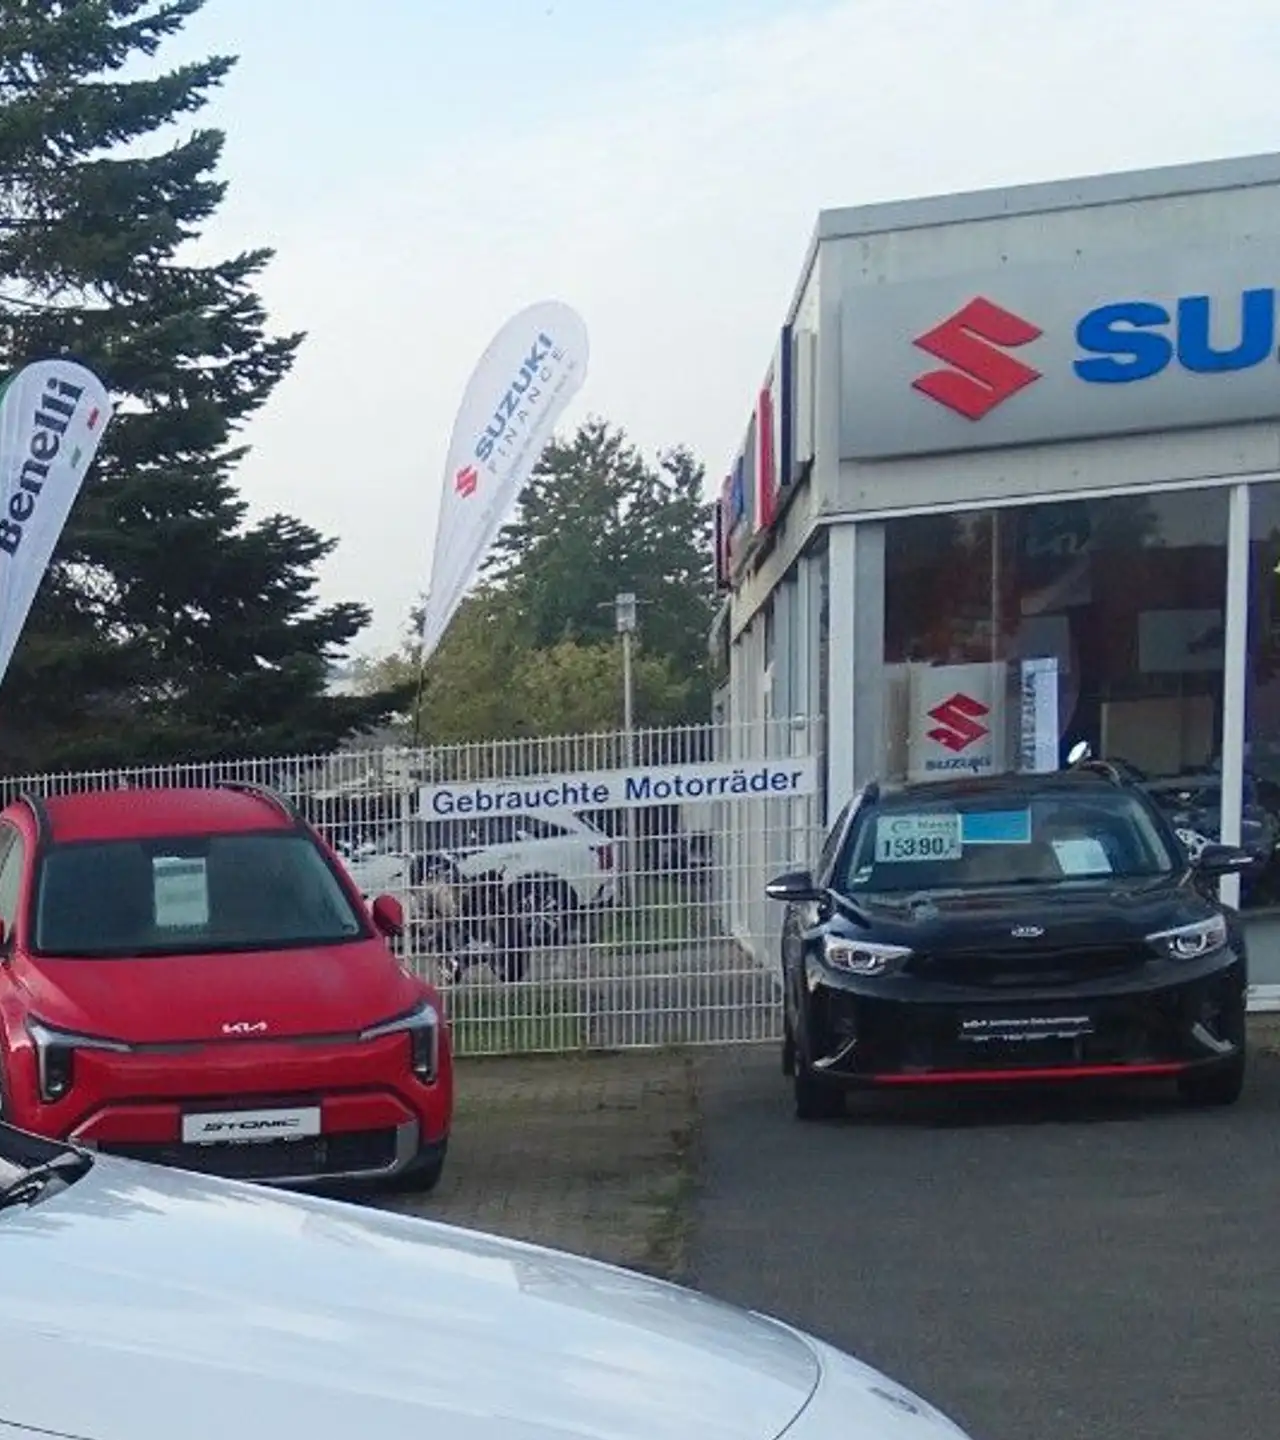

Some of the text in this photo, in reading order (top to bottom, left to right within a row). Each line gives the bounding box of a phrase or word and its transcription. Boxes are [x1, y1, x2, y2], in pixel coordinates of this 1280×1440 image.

[1073, 287, 1280, 383] SU
[474, 331, 553, 463] SUZUKI
[487, 347, 568, 474] FINANCE
[432, 767, 804, 815] Gebrauchte Motorräder
